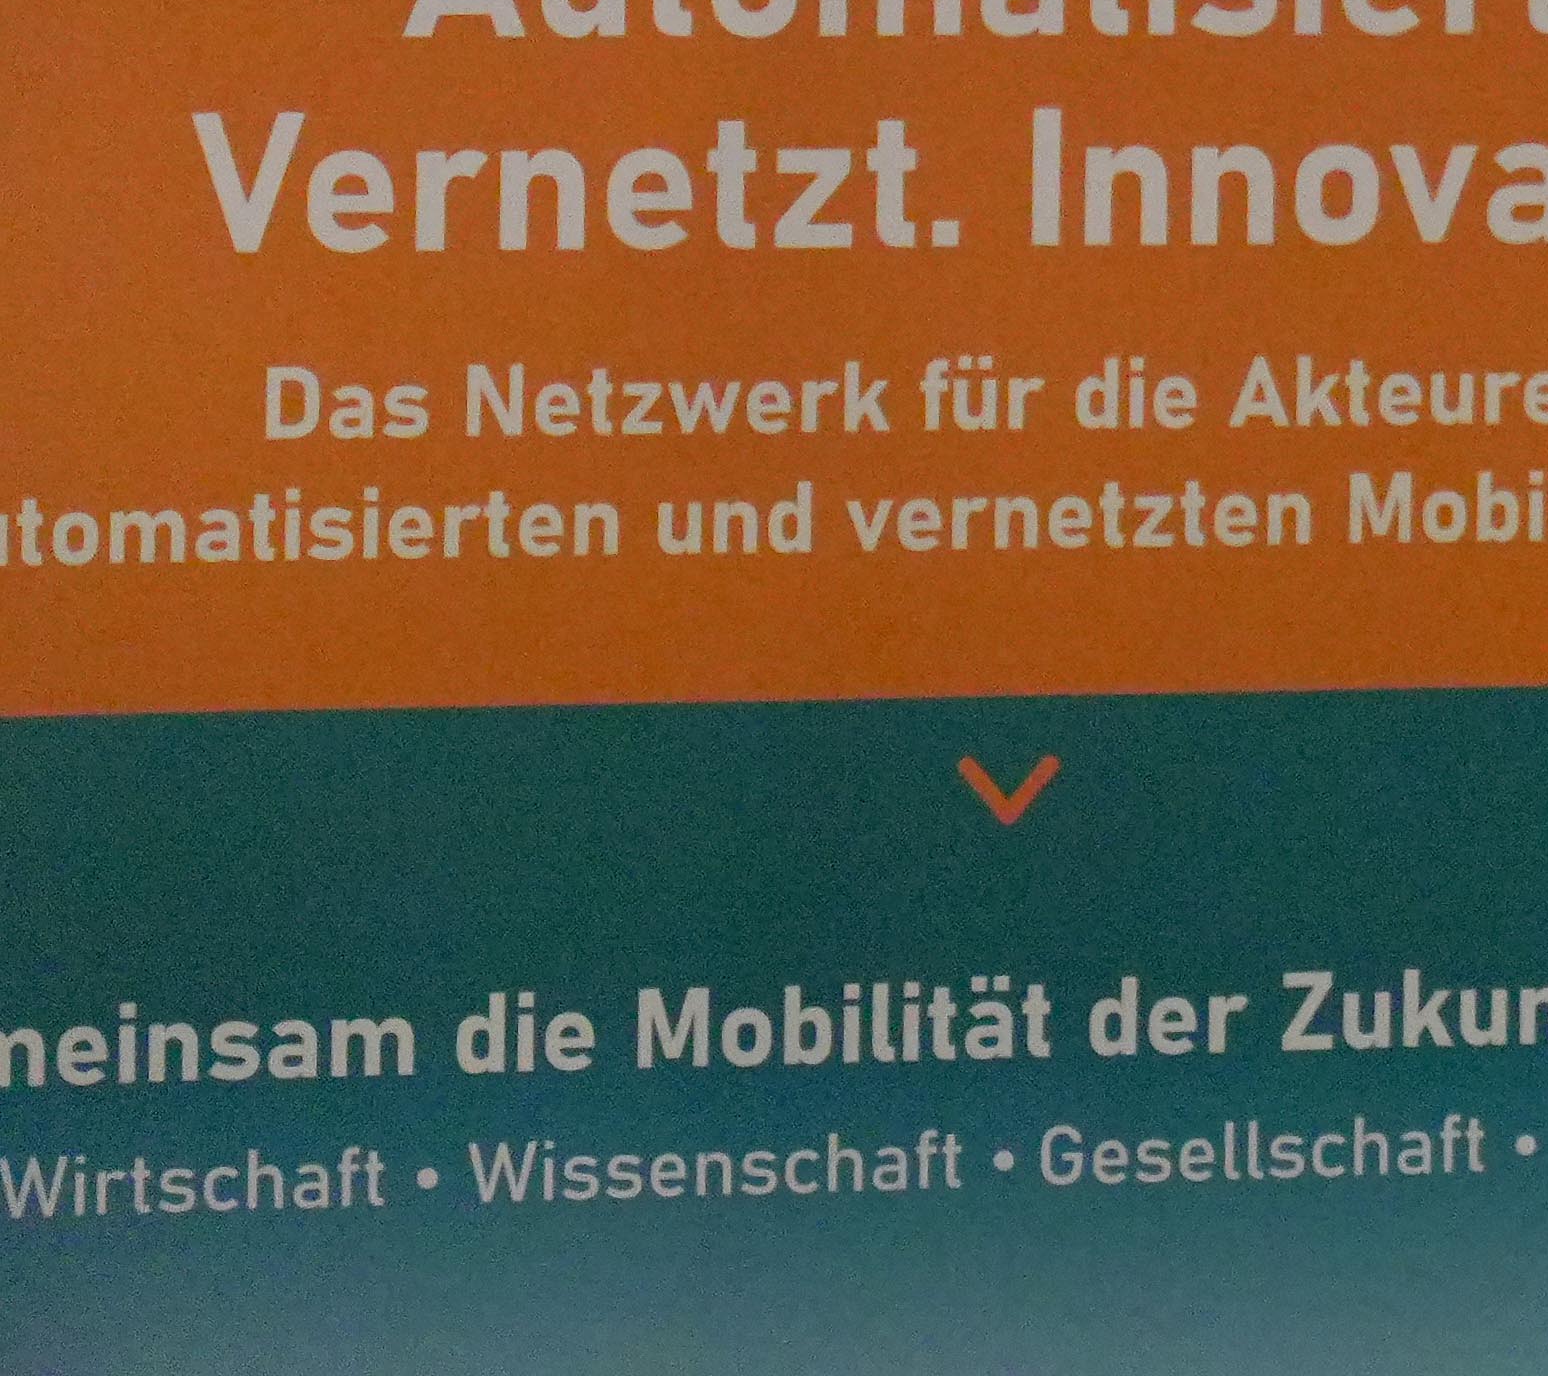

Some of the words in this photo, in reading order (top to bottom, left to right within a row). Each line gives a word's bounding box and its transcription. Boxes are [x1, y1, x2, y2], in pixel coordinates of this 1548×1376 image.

[192, 111, 959, 252] Vernetzt.
[266, 366, 428, 439] Das
[467, 361, 889, 436] Netzwerk
[921, 355, 1044, 430] für
[1076, 357, 1197, 428] die
[0, 487, 619, 566] tomatisierten
[658, 481, 813, 554] und
[848, 480, 1311, 551] vernetzten
[456, 992, 595, 1074] die
[637, 975, 1050, 1068] Mobilität
[1090, 976, 1248, 1056] der
[0, 1146, 384, 1218] Wirtschaft
[469, 1129, 962, 1203] Wissenschaft
[1041, 1114, 1484, 1185] Gesellschaft
